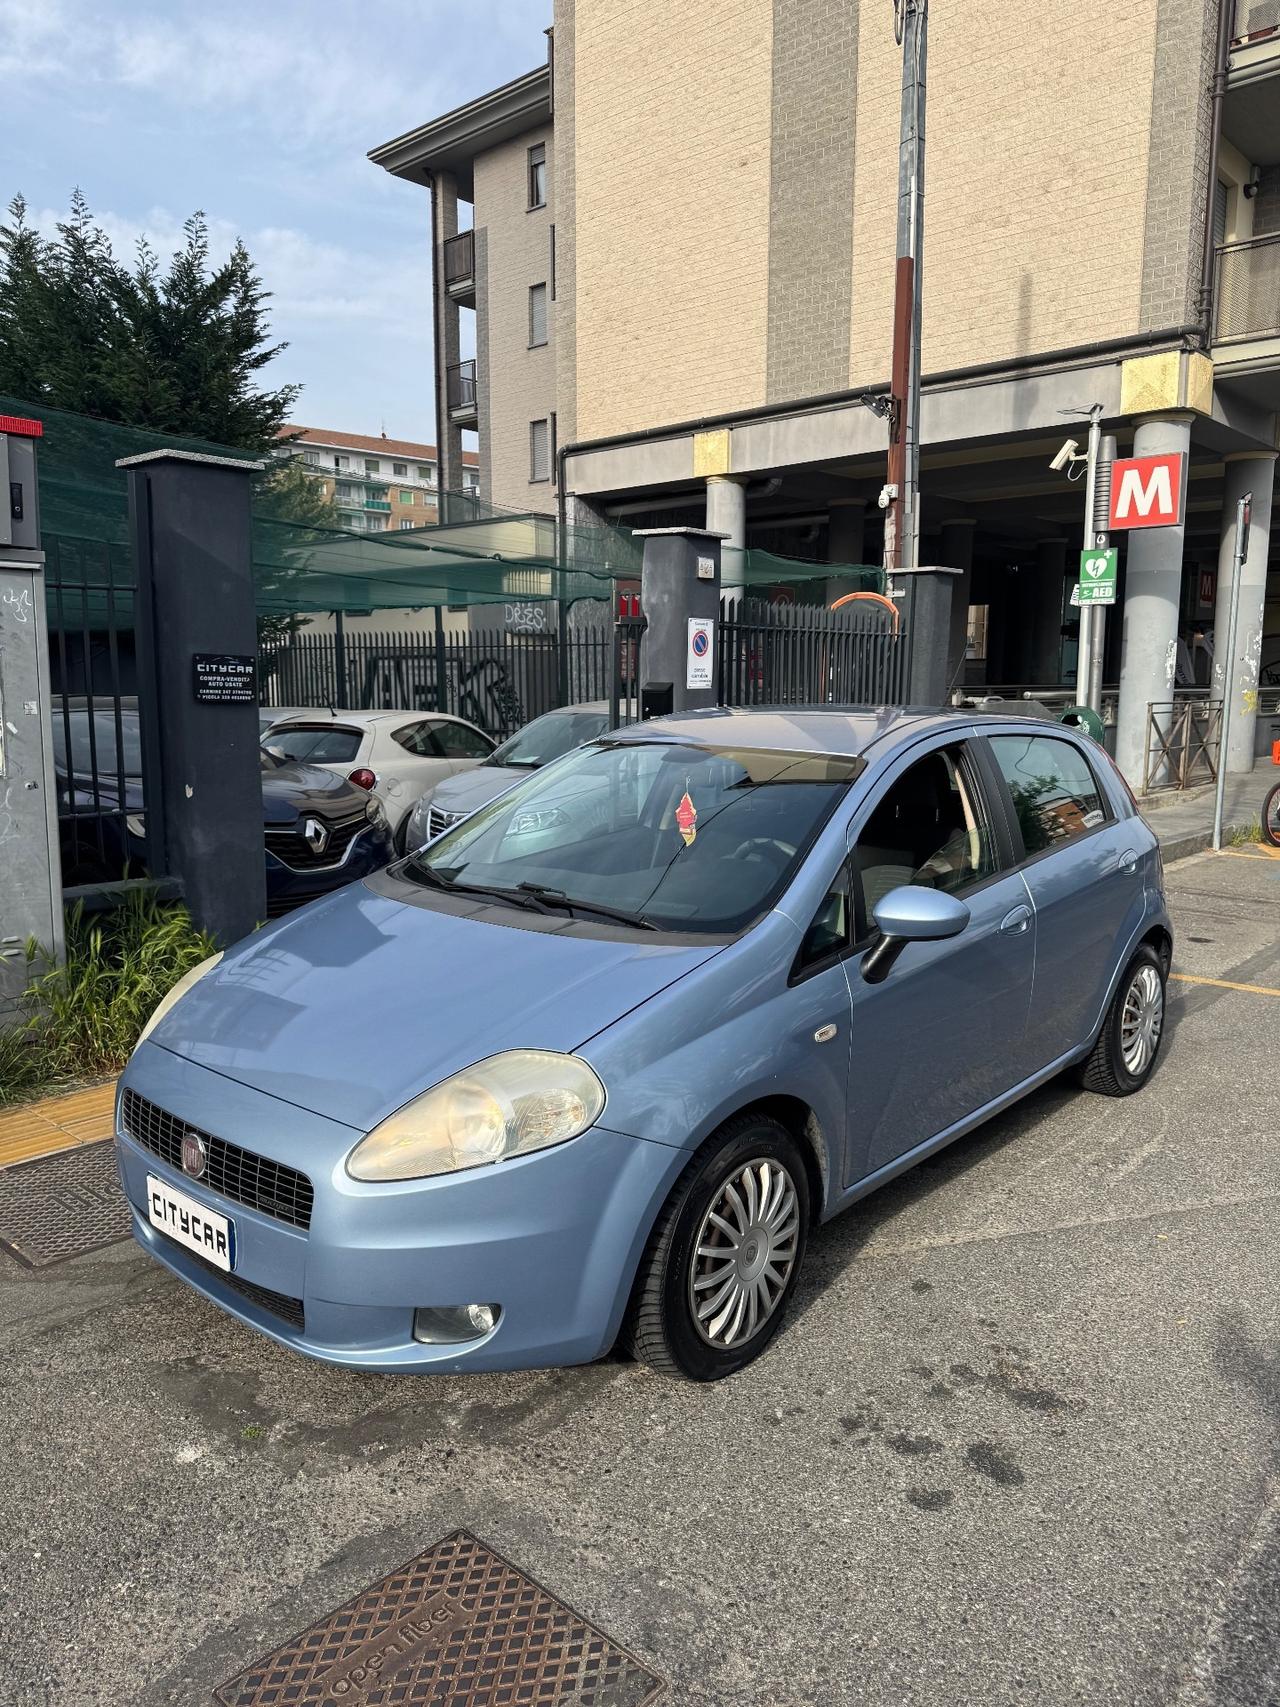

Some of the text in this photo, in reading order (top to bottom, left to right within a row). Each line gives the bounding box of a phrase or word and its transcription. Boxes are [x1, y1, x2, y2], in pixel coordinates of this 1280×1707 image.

[1115, 465, 1173, 518] M
[1092, 587, 1113, 598] AED
[197, 664, 253, 673] CITYCAR
[152, 1192, 227, 1257] CITYCAR
[330, 1643, 405, 1697] open
